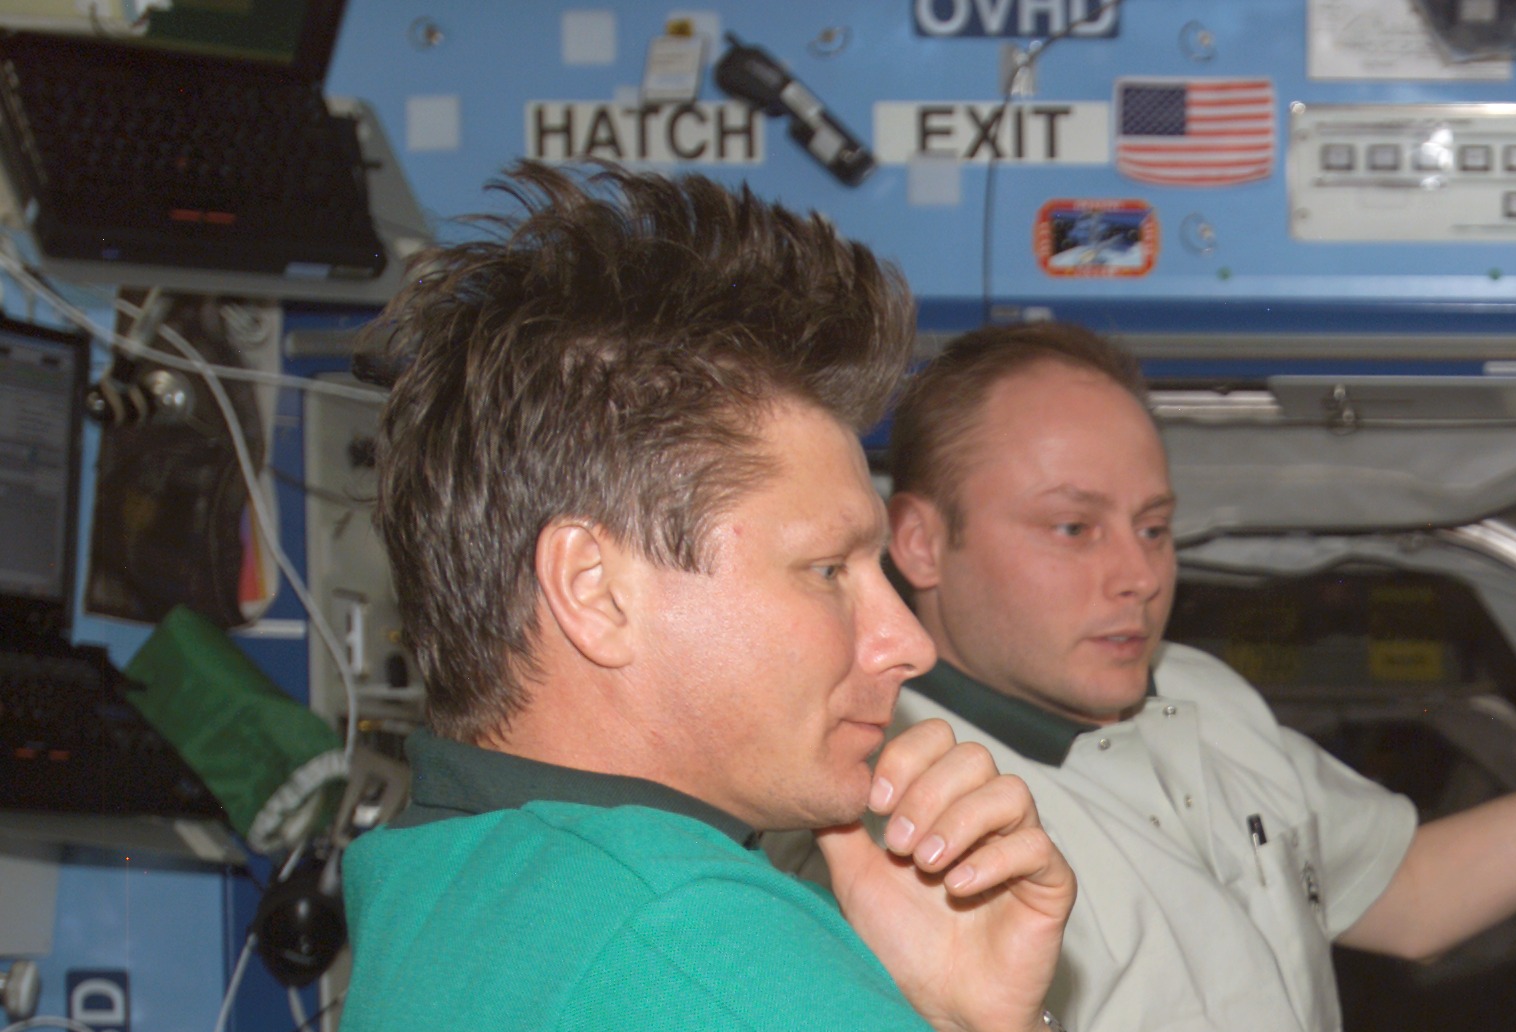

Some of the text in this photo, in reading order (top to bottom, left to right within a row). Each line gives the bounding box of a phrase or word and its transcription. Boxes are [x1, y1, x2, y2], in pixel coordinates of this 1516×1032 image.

[915, 0, 1117, 35] OVHD
[534, 104, 755, 160] HATCH
[917, 105, 1072, 158] EXIT
